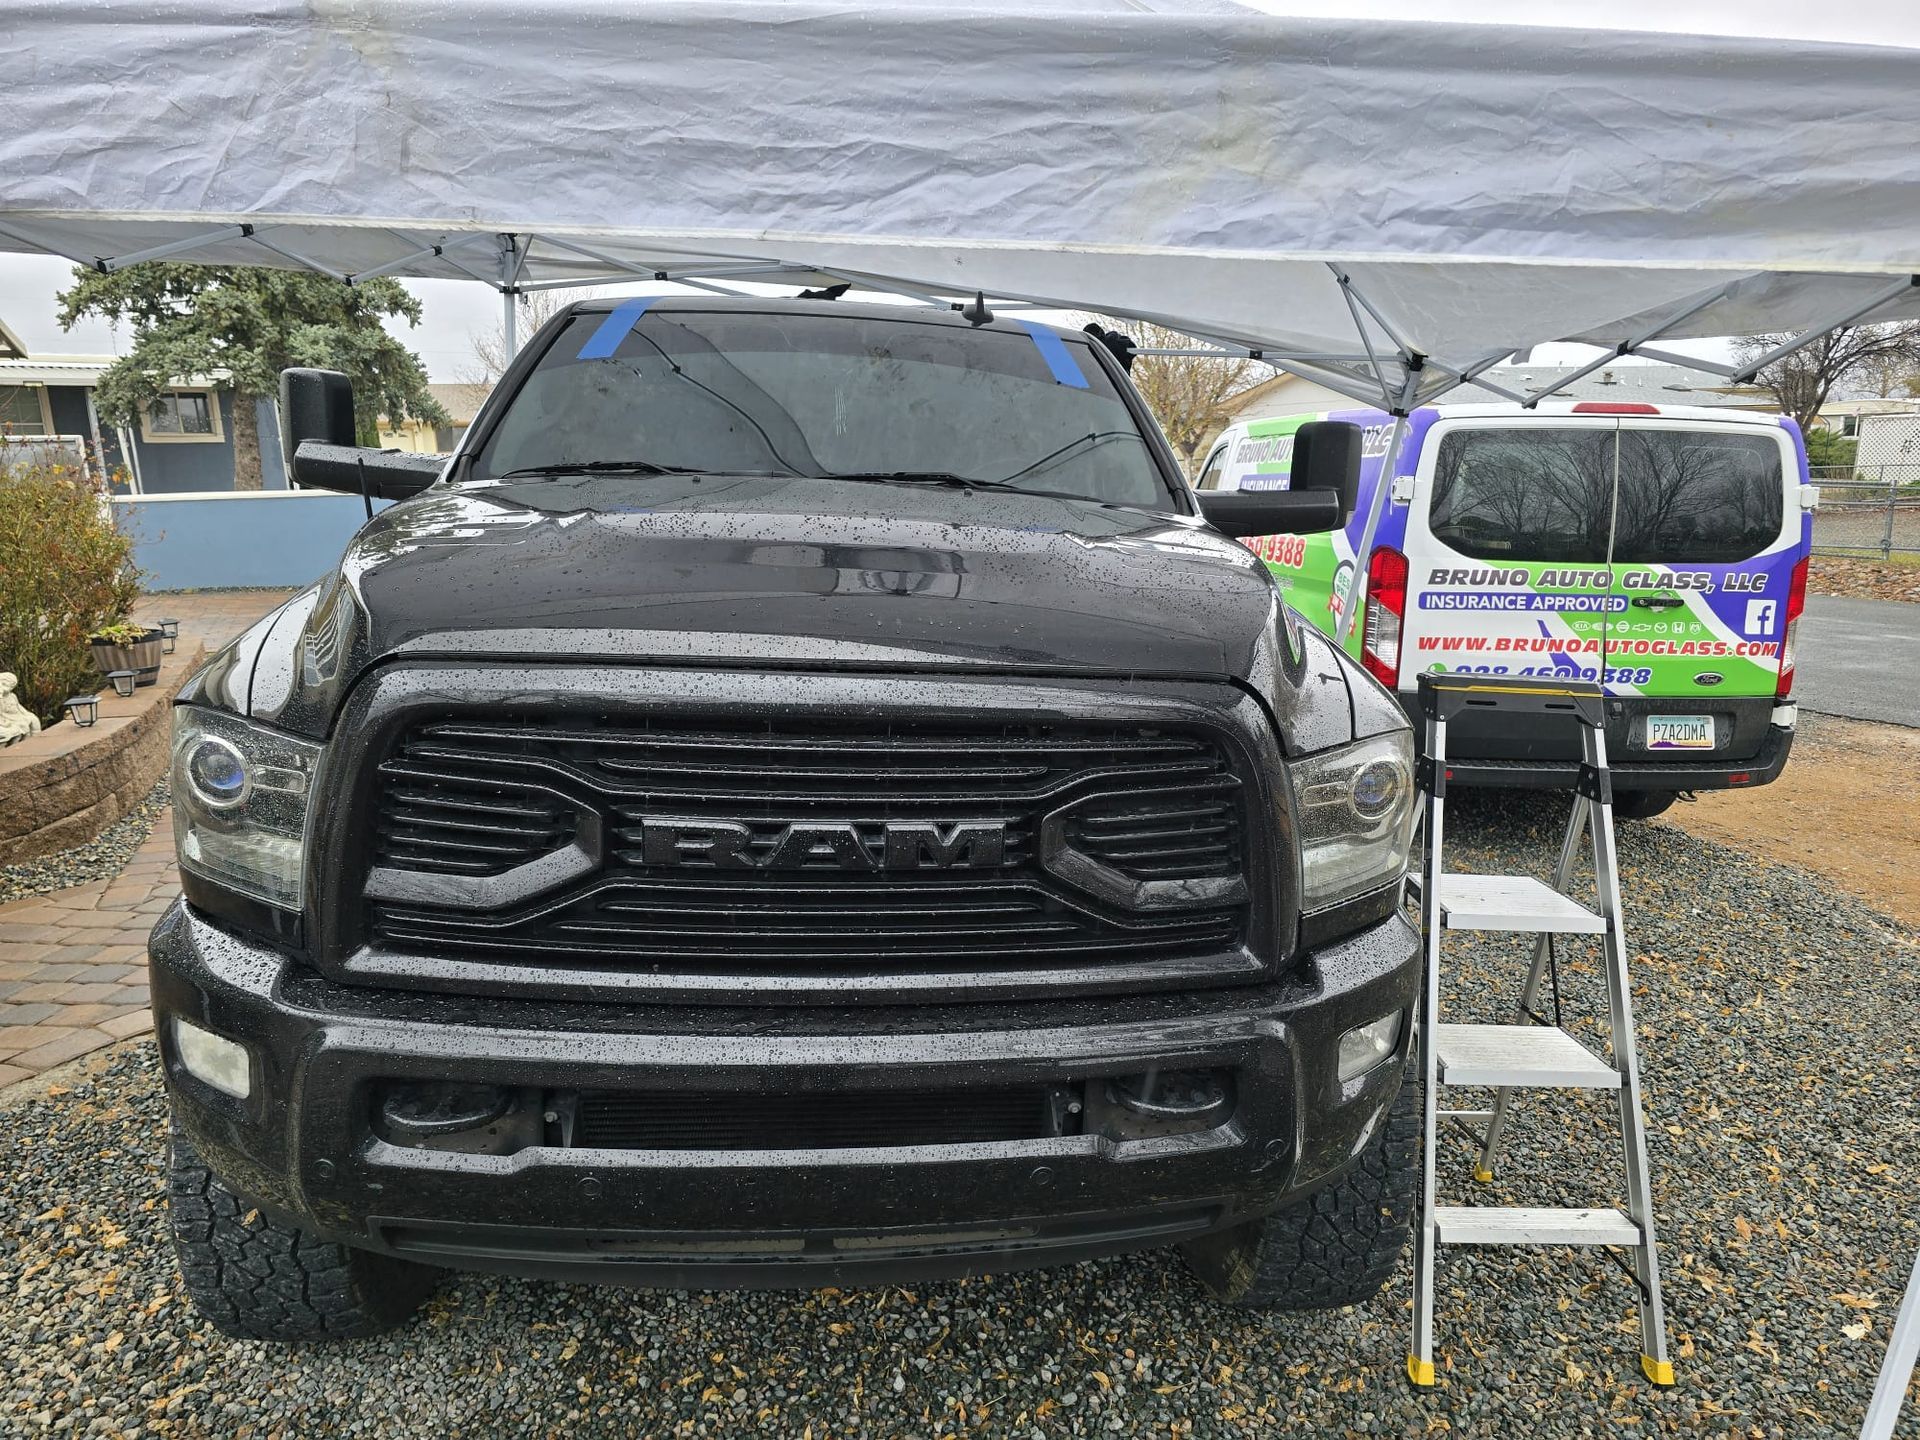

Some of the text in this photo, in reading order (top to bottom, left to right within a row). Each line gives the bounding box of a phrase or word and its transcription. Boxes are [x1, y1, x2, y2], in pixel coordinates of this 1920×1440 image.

[1236, 441, 1271, 463] BRUNO
[1428, 569, 1767, 592] BRUNO AUTO GLASS, LLC
[1425, 595, 1625, 611] INSURANCE APPROVED
[1418, 637, 1778, 656] WWW.BRUNOAUTOGLASS.COM
[1653, 724, 1706, 741] PZA2DMA
[641, 818, 1007, 868] RAM
